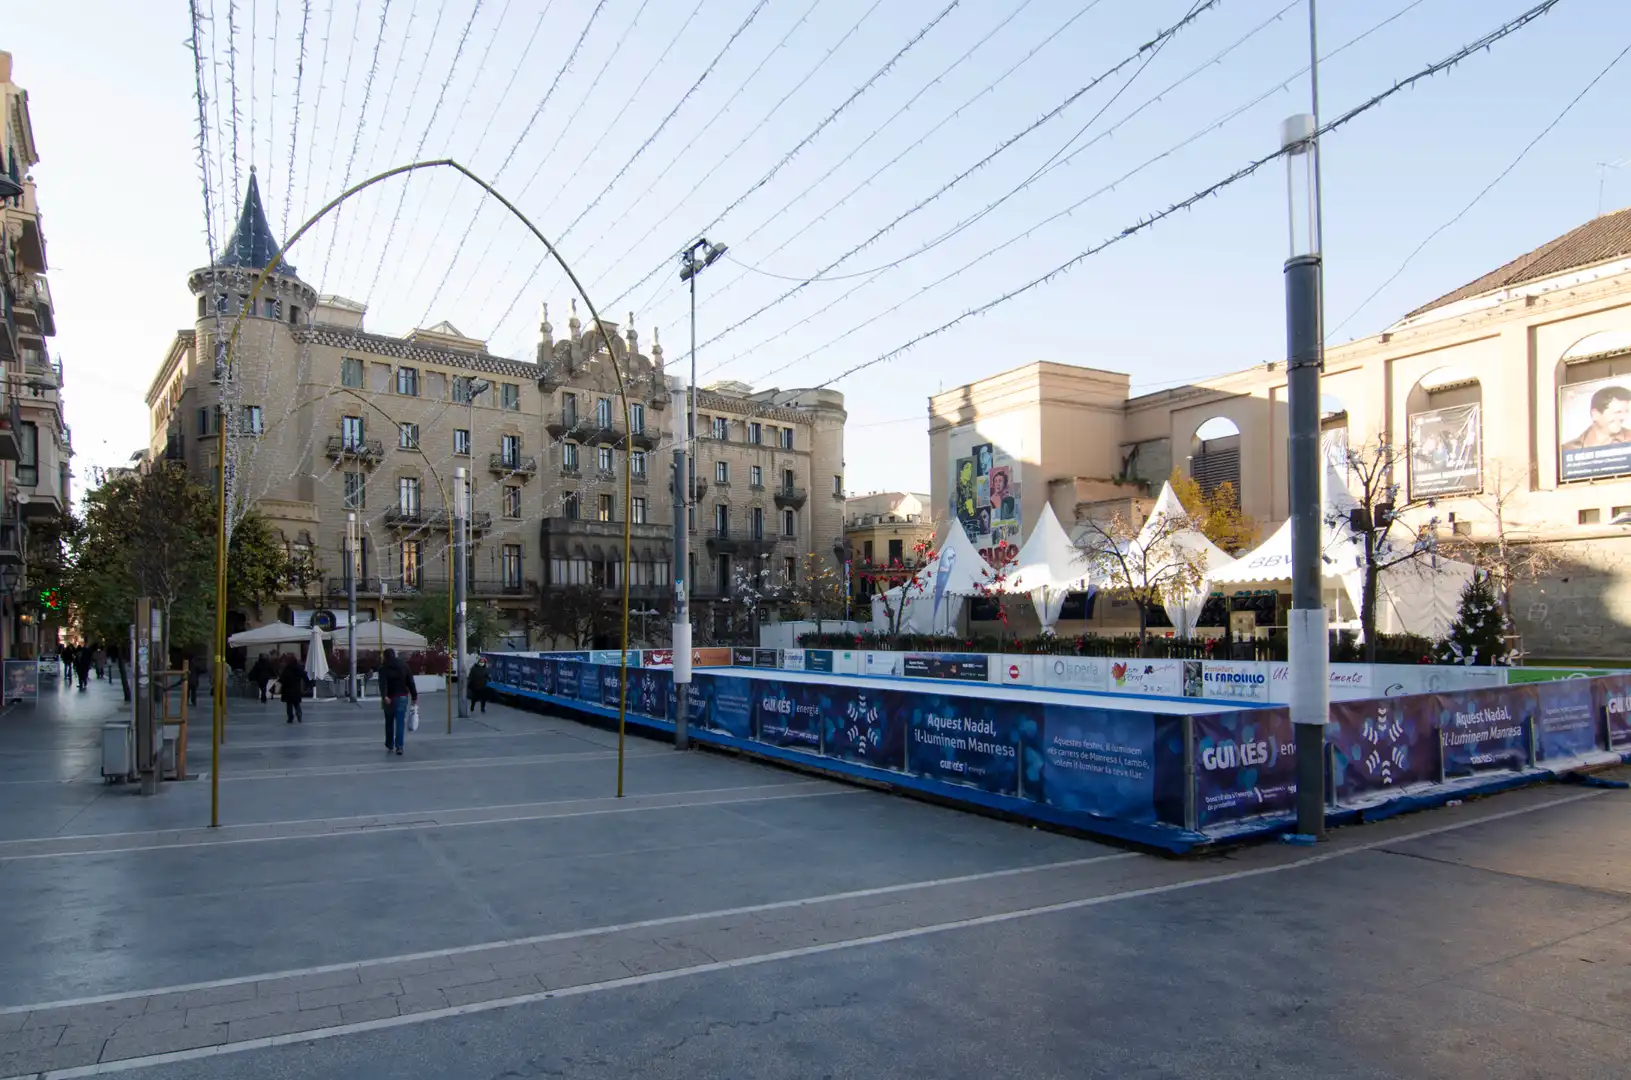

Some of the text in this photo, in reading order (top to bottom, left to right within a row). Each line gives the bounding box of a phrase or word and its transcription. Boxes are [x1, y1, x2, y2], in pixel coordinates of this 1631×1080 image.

[1204, 672, 1265, 684] EL FAROLILLO
[796, 704, 819, 717] energia
[1455, 706, 1512, 729] Aquest Nadal,
[927, 713, 997, 737] Aquest Nadal,
[1488, 724, 1522, 741] Manresa
[914, 729, 1015, 757] il·luminem Manresa
[1053, 736, 1081, 747] Aquestes
[1089, 752, 1118, 765] Manresa
